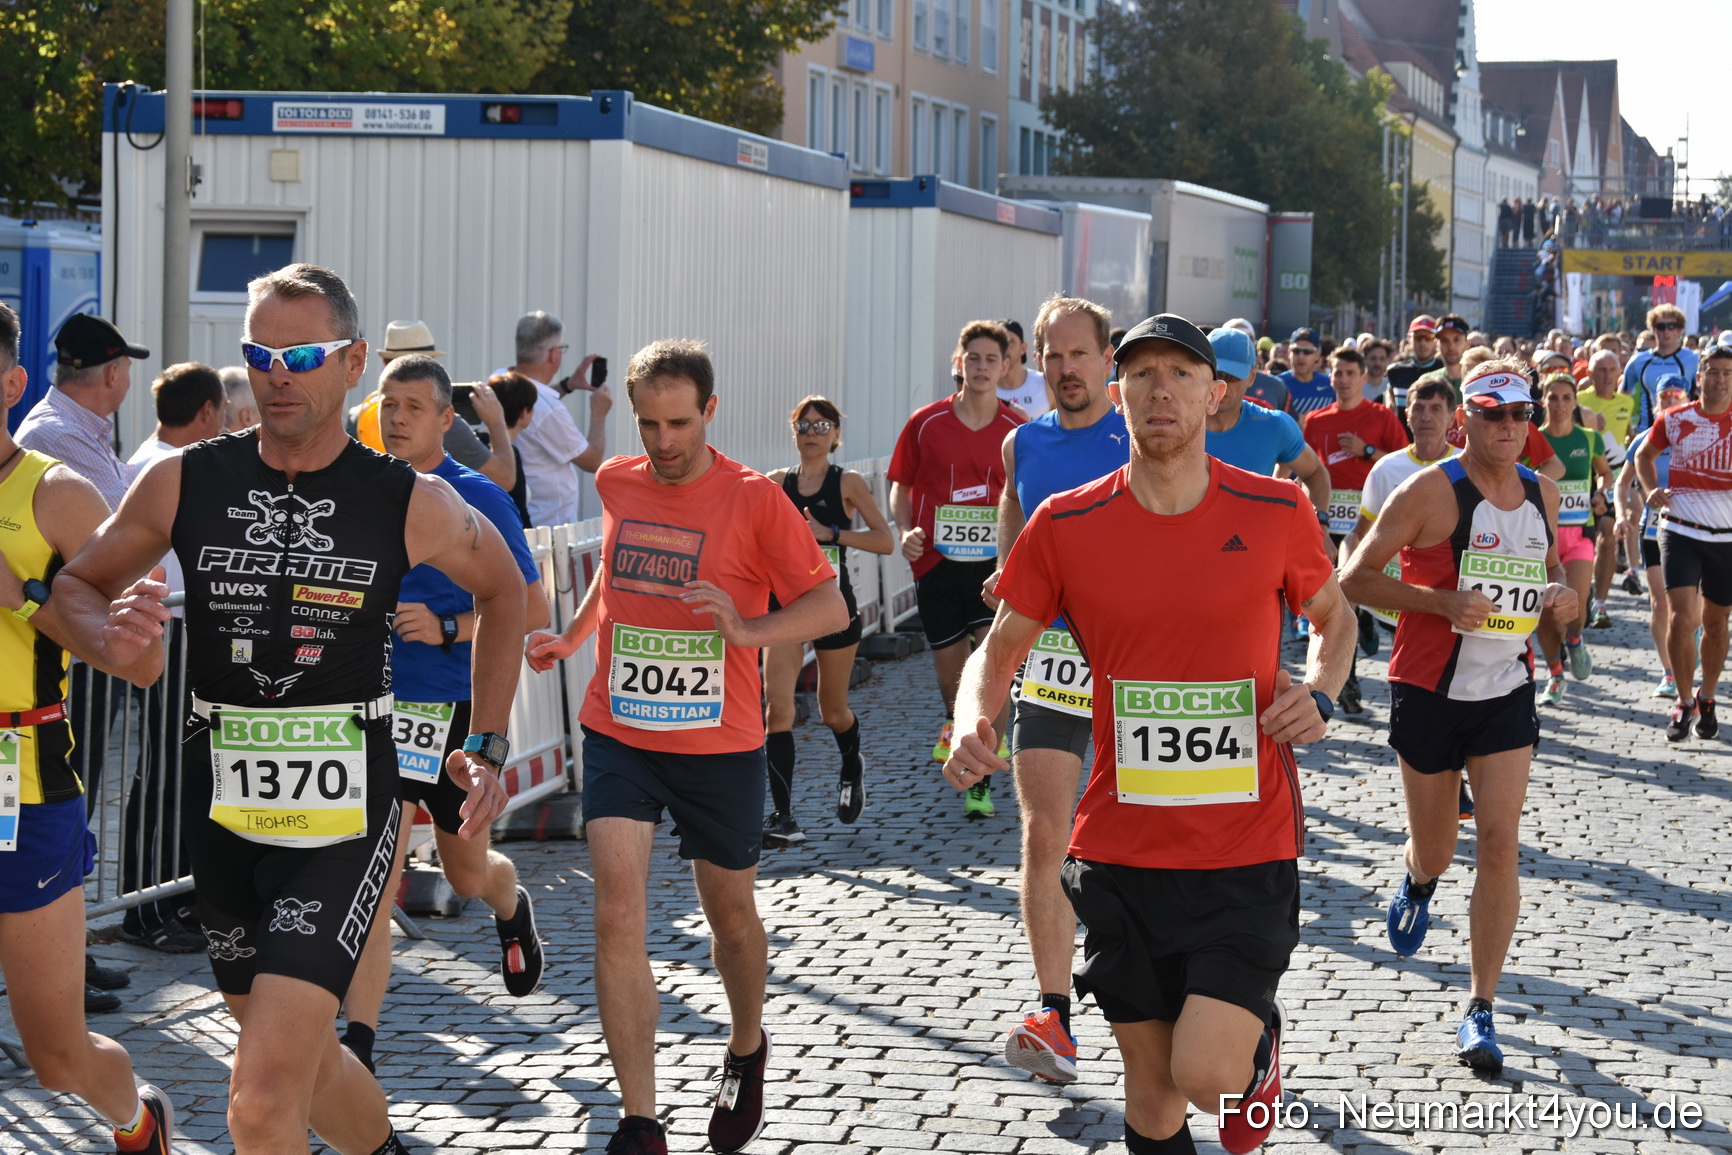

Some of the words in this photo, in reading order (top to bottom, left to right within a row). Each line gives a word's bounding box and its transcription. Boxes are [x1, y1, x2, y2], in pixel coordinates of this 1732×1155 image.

[279, 107, 297, 118] TOI
[300, 107, 318, 118] TOI
[328, 107, 352, 119] DIXI
[1623, 255, 1685, 271] START
[227, 507, 257, 520] Team
[941, 508, 993, 521] BOCK
[942, 525, 991, 542] 2562
[1476, 533, 1495, 544] tkn
[948, 547, 984, 555] FABIAN
[197, 546, 377, 585] PIRATE
[616, 549, 692, 583] 0774600
[1468, 556, 1542, 580] BOCK
[210, 582, 268, 597] uvex
[209, 601, 262, 611] Continental
[1487, 617, 1515, 631] UDO
[620, 630, 714, 656] BOCK
[621, 662, 710, 697] 2042
[1040, 657, 1093, 688] 107
[619, 701, 711, 719] CHRISTIAN
[1124, 686, 1243, 714] BOCK
[221, 717, 350, 746] BOCK
[393, 717, 436, 749] 38
[1132, 725, 1240, 763] 1364
[230, 759, 348, 801] 1370
[239, 809, 309, 830] THOMAS
[336, 797, 400, 961] PIRATE
